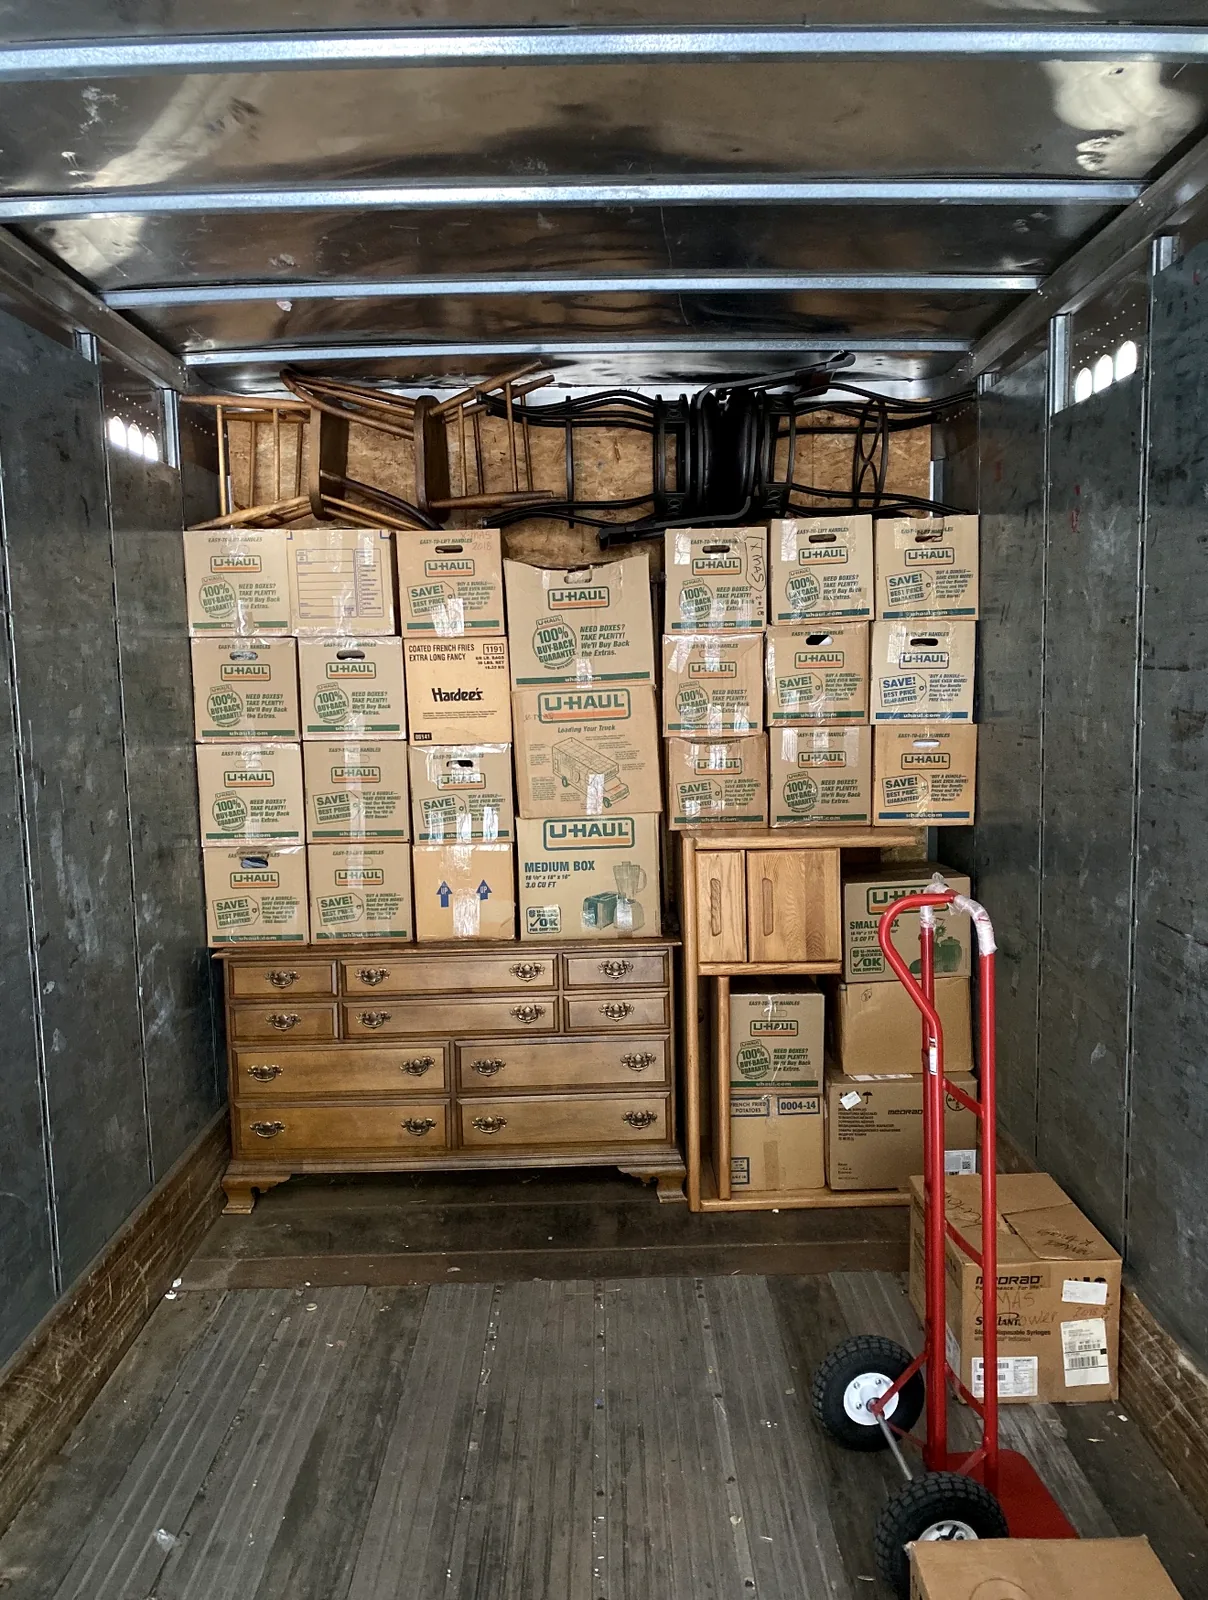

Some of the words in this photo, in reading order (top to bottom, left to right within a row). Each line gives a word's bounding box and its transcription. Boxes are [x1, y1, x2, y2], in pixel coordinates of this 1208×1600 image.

[802, 550, 845, 558] U-HAUL
[908, 551, 951, 559] U-HAUL
[428, 562, 471, 570] U-HAUL
[695, 561, 738, 569] U-HAUL
[790, 576, 814, 590] 100%
[889, 574, 922, 586] SAVE!
[203, 584, 229, 597] 100%
[411, 585, 444, 597] SAVE!
[552, 591, 605, 601] U-HAUL
[684, 587, 707, 599] 100%
[537, 626, 568, 643] 100%
[537, 639, 575, 655] BUY-BACK
[798, 654, 841, 662] U-HAUL
[780, 676, 812, 688] SAVE!
[883, 677, 916, 688] SAVE!
[211, 693, 236, 706] 100%
[318, 691, 342, 704] 100%
[432, 688, 483, 702] Hardee's
[680, 691, 703, 702] 100%
[317, 701, 346, 712] BUY-BACK
[544, 694, 624, 711] U-HAUL
[211, 704, 240, 714] BUY-BACK
[680, 782, 711, 793] SAVE!
[787, 780, 812, 792] 100%
[886, 777, 918, 788] SAVE!
[216, 799, 240, 811] 100%
[317, 794, 349, 806] SAVE!
[424, 798, 455, 810] SAVE!
[550, 823, 628, 838] U-HAUL
[525, 862, 569, 872] MEDIUM
[574, 861, 595, 871] BOX
[216, 899, 248, 911] SAVE!
[321, 896, 352, 908] SAVE!
[850, 921, 879, 929] SMALL
[863, 958, 881, 966] OK
[741, 1048, 765, 1060] 100%
[740, 1058, 768, 1067] BUY-BACK
[781, 1101, 816, 1110] 0004-14
[976, 1276, 1040, 1284] MDRAD
